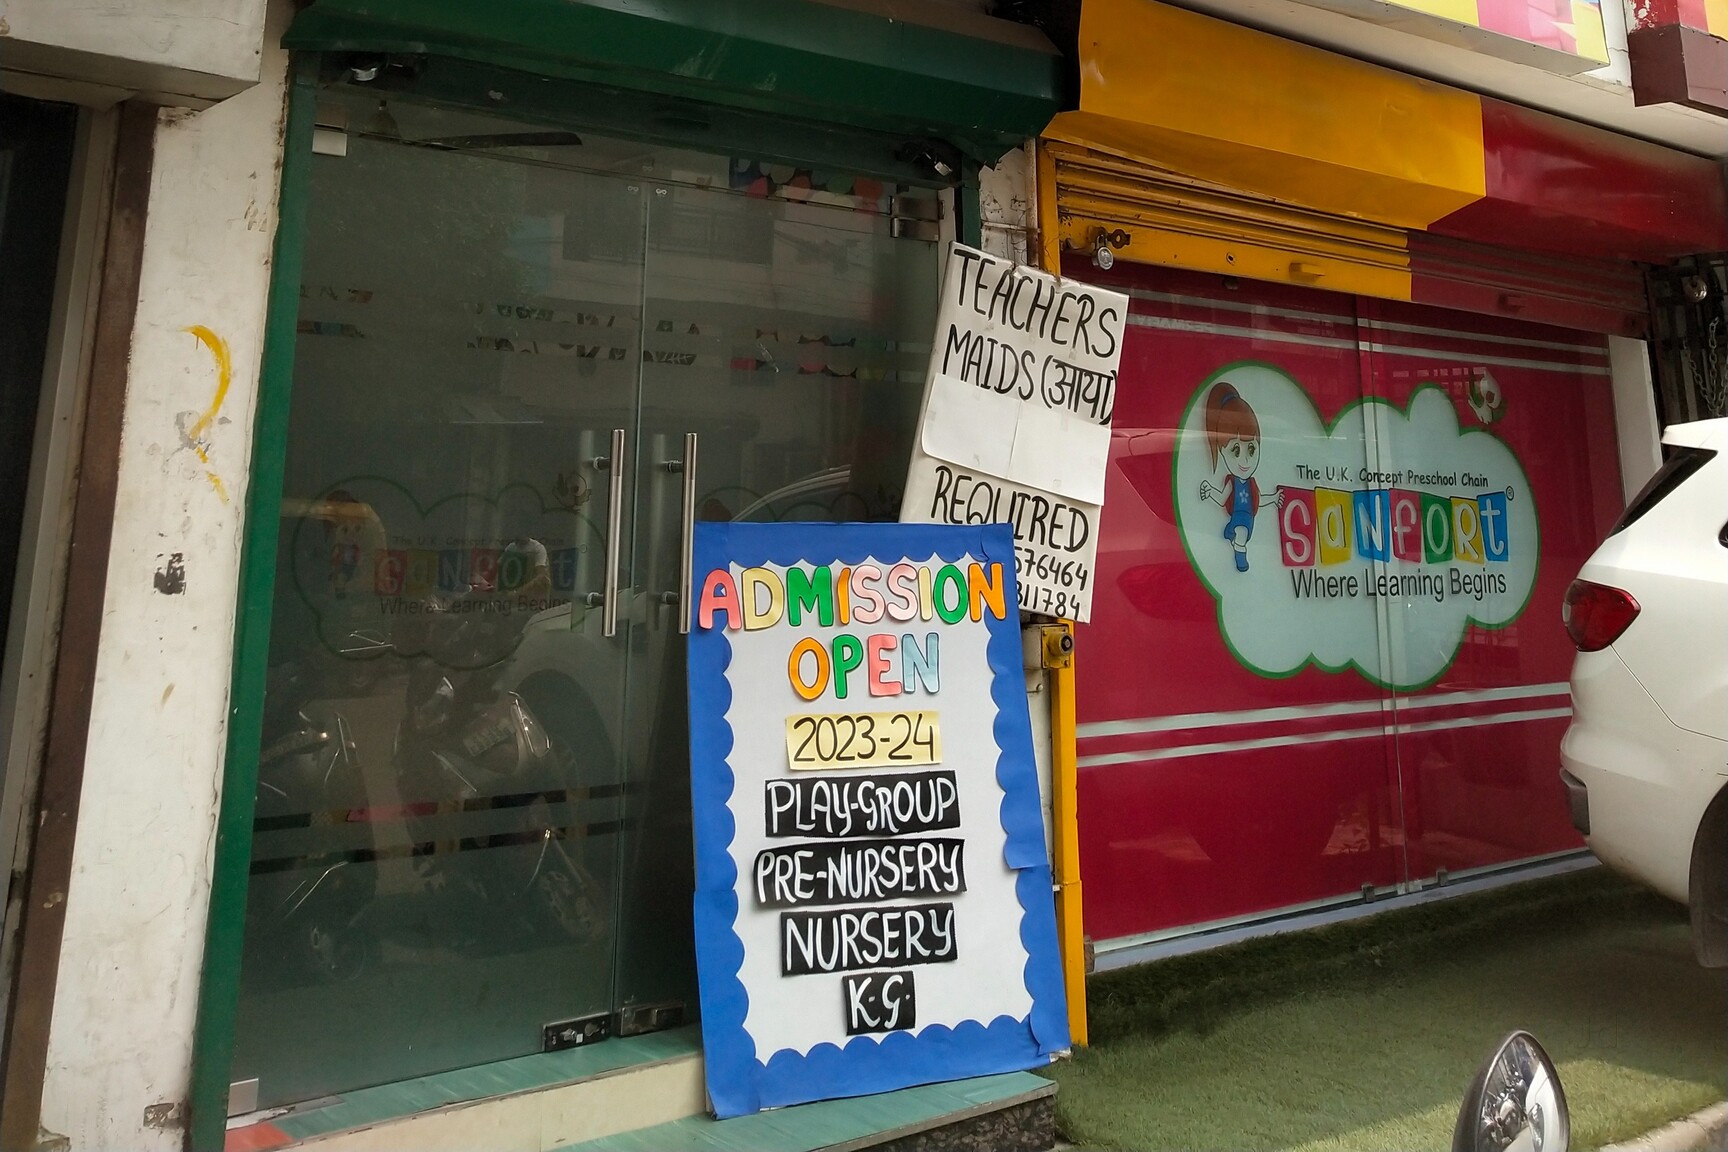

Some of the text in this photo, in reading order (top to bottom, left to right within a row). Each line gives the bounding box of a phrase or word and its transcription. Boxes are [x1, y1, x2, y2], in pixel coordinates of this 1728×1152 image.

[953, 248, 1118, 359] TEACHERS
[942, 324, 1036, 401] MAIDS
[1296, 464, 1489, 488] The U.K. Concept Preschool Chain
[930, 465, 1090, 553] REQUIRED
[698, 562, 1007, 631] ADMISSION
[1291, 567, 1507, 602] Where Learning Begins
[788, 632, 941, 700] OPEN
[793, 713, 934, 763] 2023-24
[767, 777, 956, 836] PLAY-GROUP
[757, 843, 960, 904] PRE-NURSERY
[786, 908, 954, 971] NURSERY
